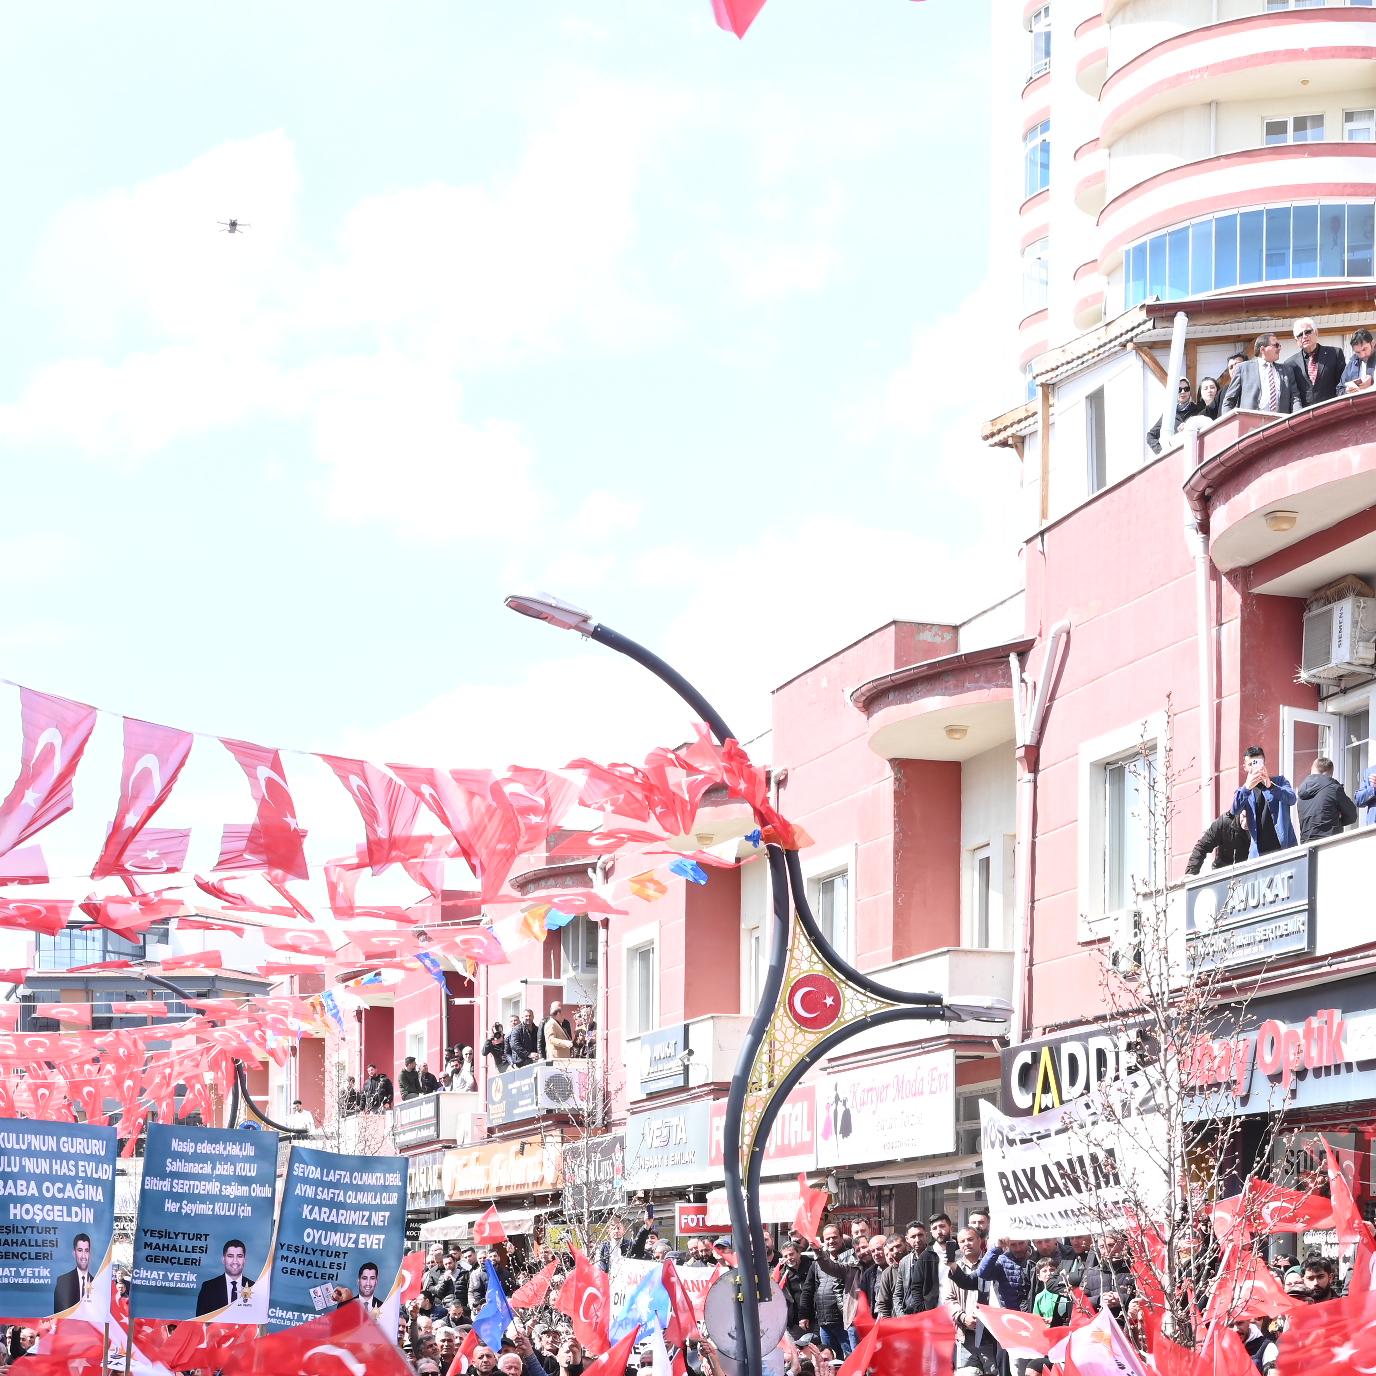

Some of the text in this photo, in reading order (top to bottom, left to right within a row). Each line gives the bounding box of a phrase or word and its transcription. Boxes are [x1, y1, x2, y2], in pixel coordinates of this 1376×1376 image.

[1257, 1009, 1344, 1089] Optik
[60, 1137, 106, 1156] GURURU
[172, 1138, 195, 1154] Nasip
[53, 1161, 75, 1177] HAS
[79, 1163, 112, 1180] EVLADI
[166, 1159, 257, 1177] Şahlanacak KULU
[293, 1163, 321, 1179] SEVDA
[323, 1167, 350, 1184] LAFTA
[352, 1172, 384, 1186] OLMAKTA
[43, 1180, 104, 1202] OCAĞINA
[145, 1177, 272, 1198] Bitirdi SERTDEMİR sağlam Okulu
[295, 1183, 397, 1205] AYNI SAFTA OLMAKLA OLUR
[10, 1203, 93, 1224] HOŞGELDİN
[165, 1199, 252, 1219] Her Şeyimiz KULU için
[302, 1204, 390, 1226] KARARIMIZ NET
[142, 1229, 209, 1242] YEŞİLYTURT
[304, 1228, 385, 1250] OYUMUZ EVET
[144, 1242, 208, 1254] MAHALLESİ
[279, 1242, 348, 1260] YEŞİLYTURT
[145, 1255, 201, 1266] GENÇLERİ
[280, 1255, 346, 1270] MAHALLESİ
[19, 1266, 50, 1277] YETİK
[133, 1268, 197, 1282] CİHAT YETİK
[282, 1266, 339, 1282] GENÇLERİ
[269, 1307, 300, 1319] CİHAT
